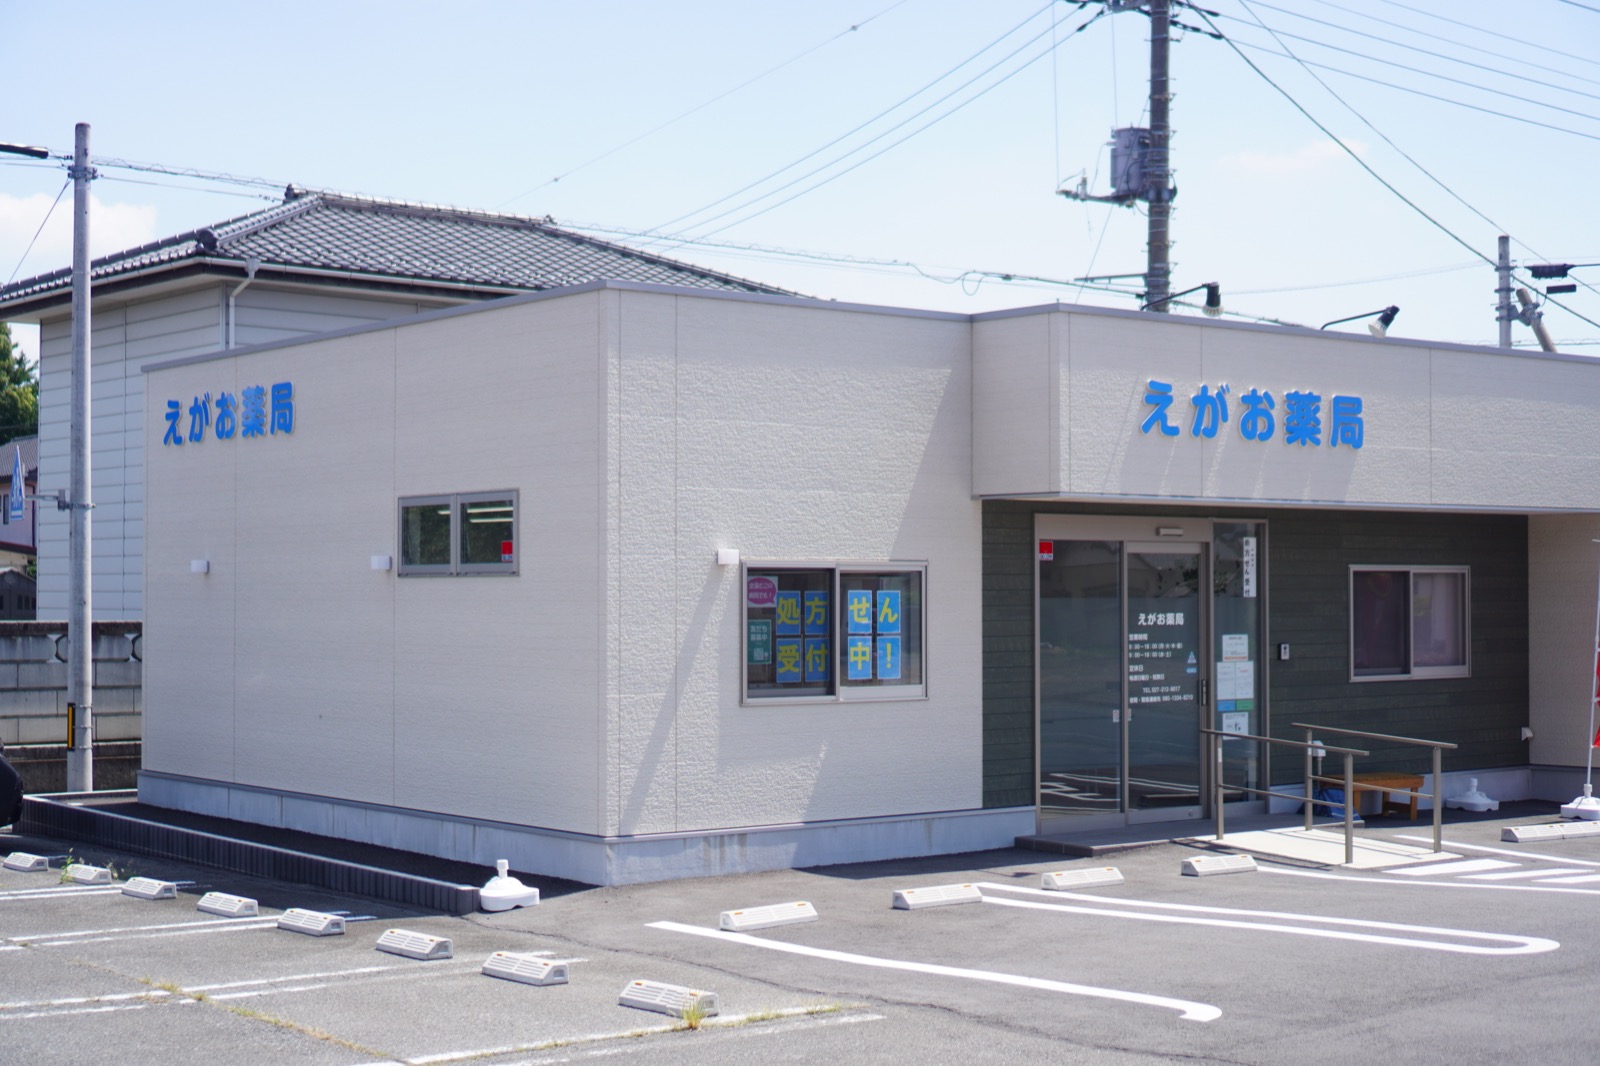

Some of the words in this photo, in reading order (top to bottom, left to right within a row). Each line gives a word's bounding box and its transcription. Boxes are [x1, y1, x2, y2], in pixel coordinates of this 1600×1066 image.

[163, 381, 294, 446] えがお薬局
[1141, 380, 1364, 449] えがお薬局
[777, 596, 898, 625] 処方せん
[1138, 612, 1185, 626] えがお薬局
[750, 625, 767, 633] 友だち
[1129, 664, 1144, 672] 定休日
